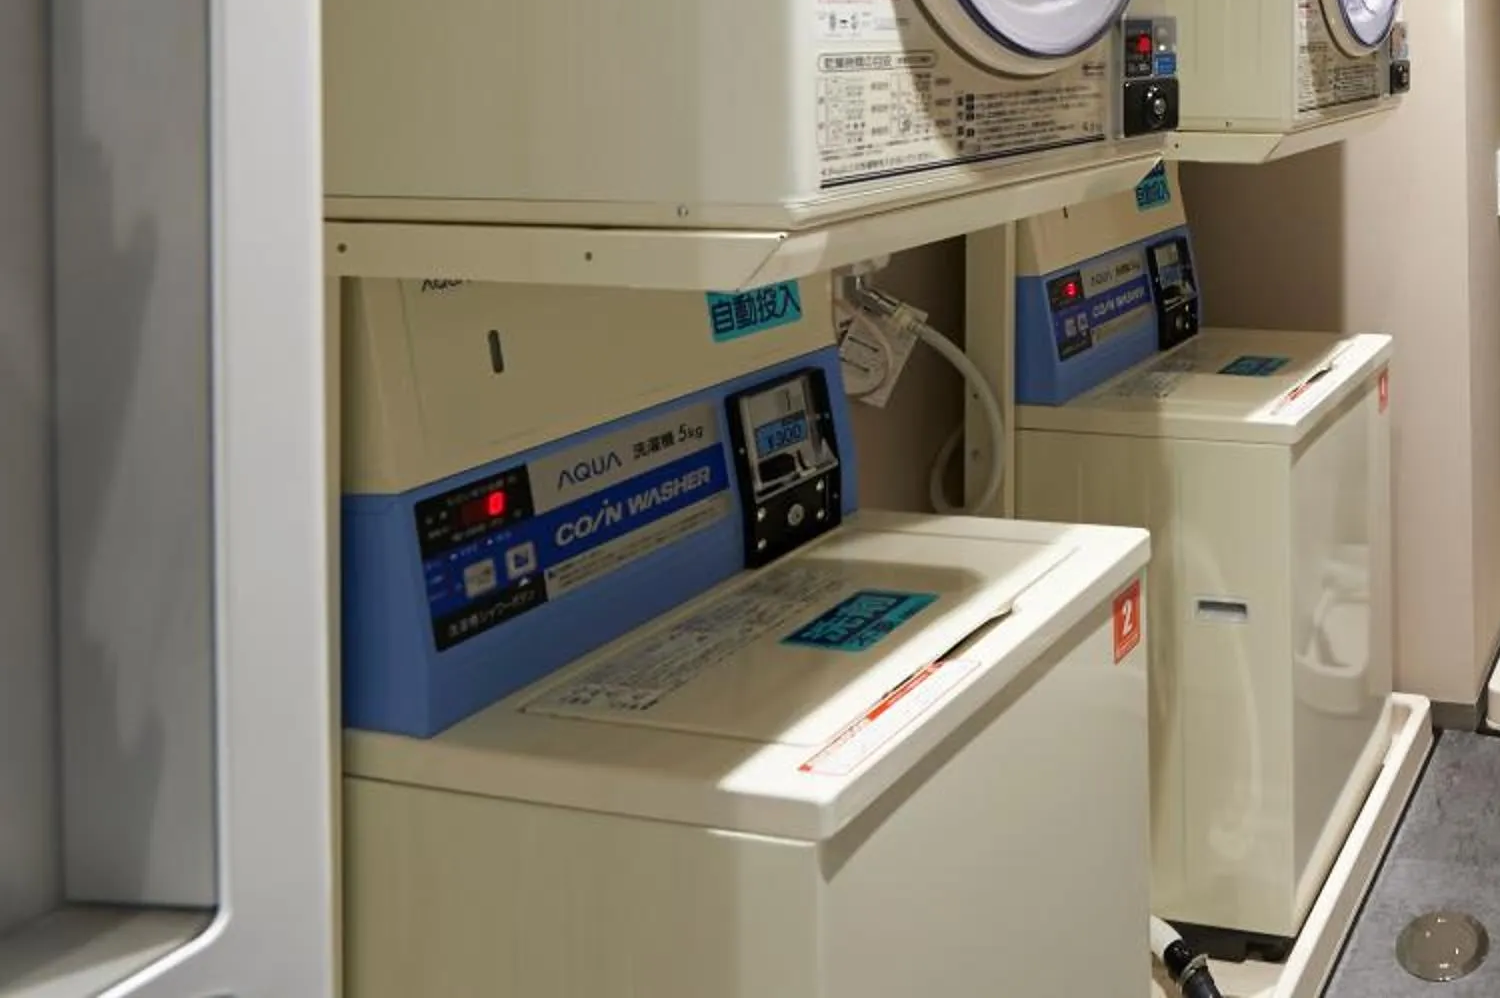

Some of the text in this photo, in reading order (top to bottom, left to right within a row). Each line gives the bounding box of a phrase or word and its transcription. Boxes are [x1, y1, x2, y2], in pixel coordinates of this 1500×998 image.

[711, 283, 801, 335] 自動投入
[557, 450, 623, 493] AQUA
[627, 465, 712, 517] WASHER
[1121, 597, 1136, 637] 2
